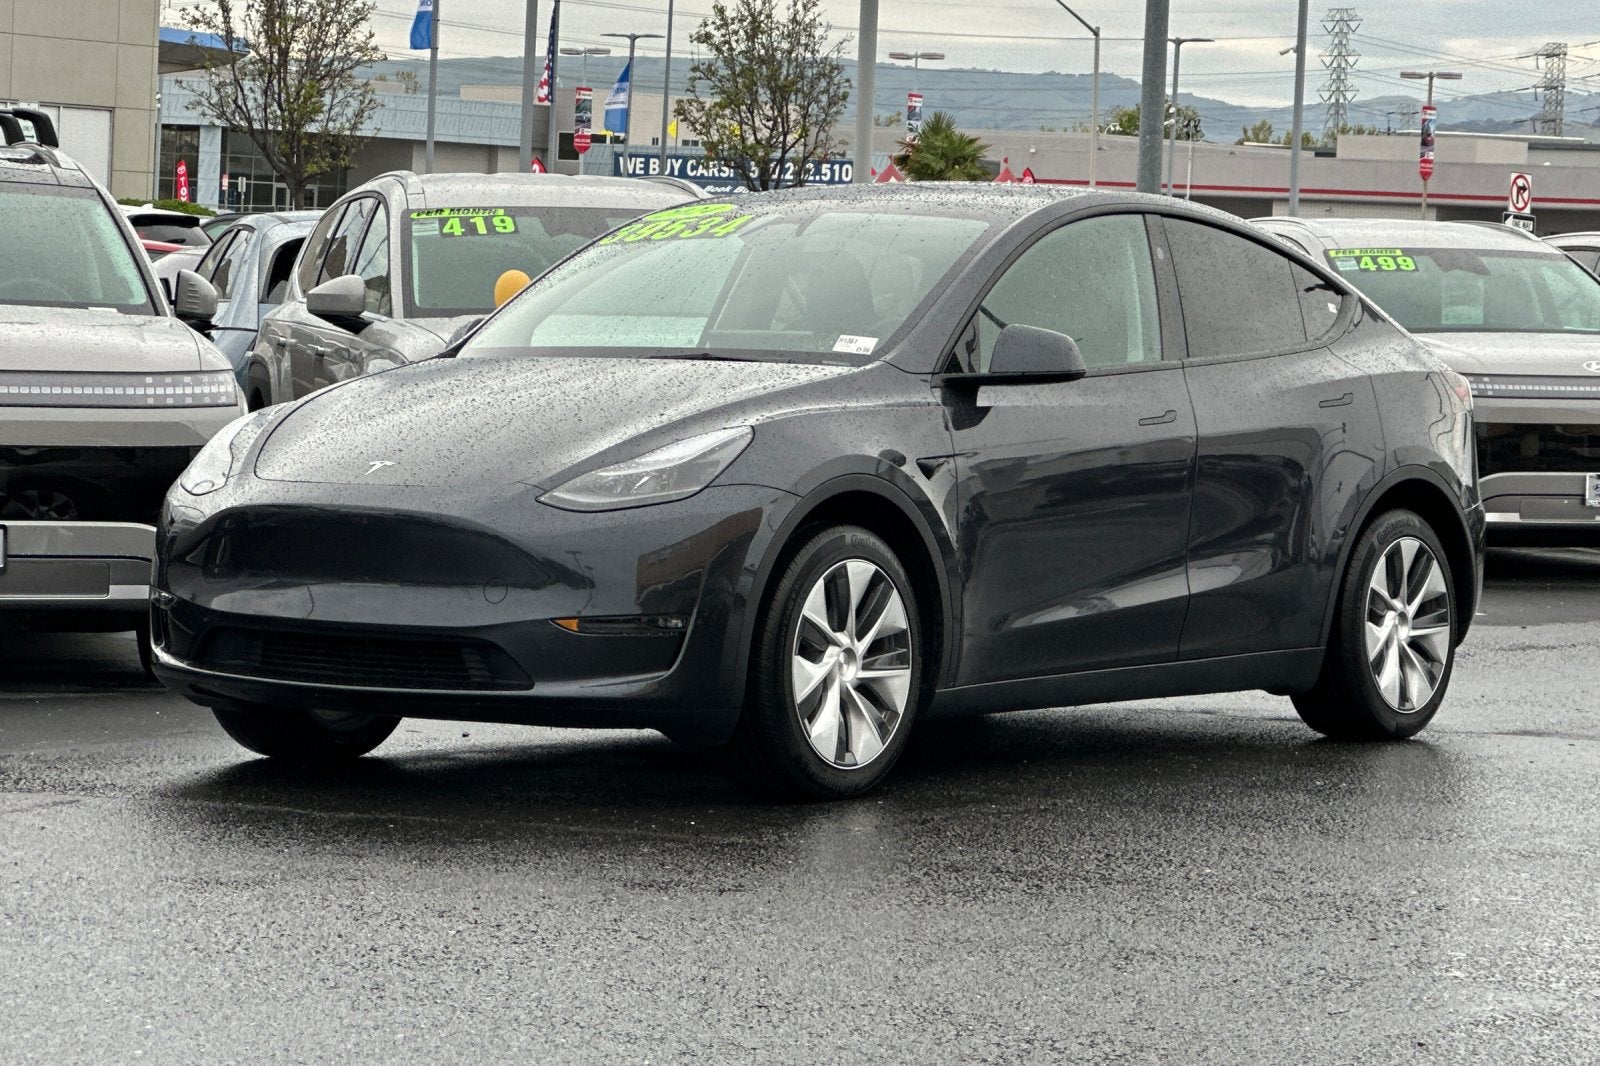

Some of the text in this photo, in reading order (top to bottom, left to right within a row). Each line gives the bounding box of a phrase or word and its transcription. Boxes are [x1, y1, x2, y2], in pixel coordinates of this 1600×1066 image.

[618, 156, 645, 174] WE
[416, 208, 497, 217] PER MONTH
[442, 216, 516, 236] 419
[599, 209, 755, 246] 39534
[1360, 256, 1416, 271] 499
